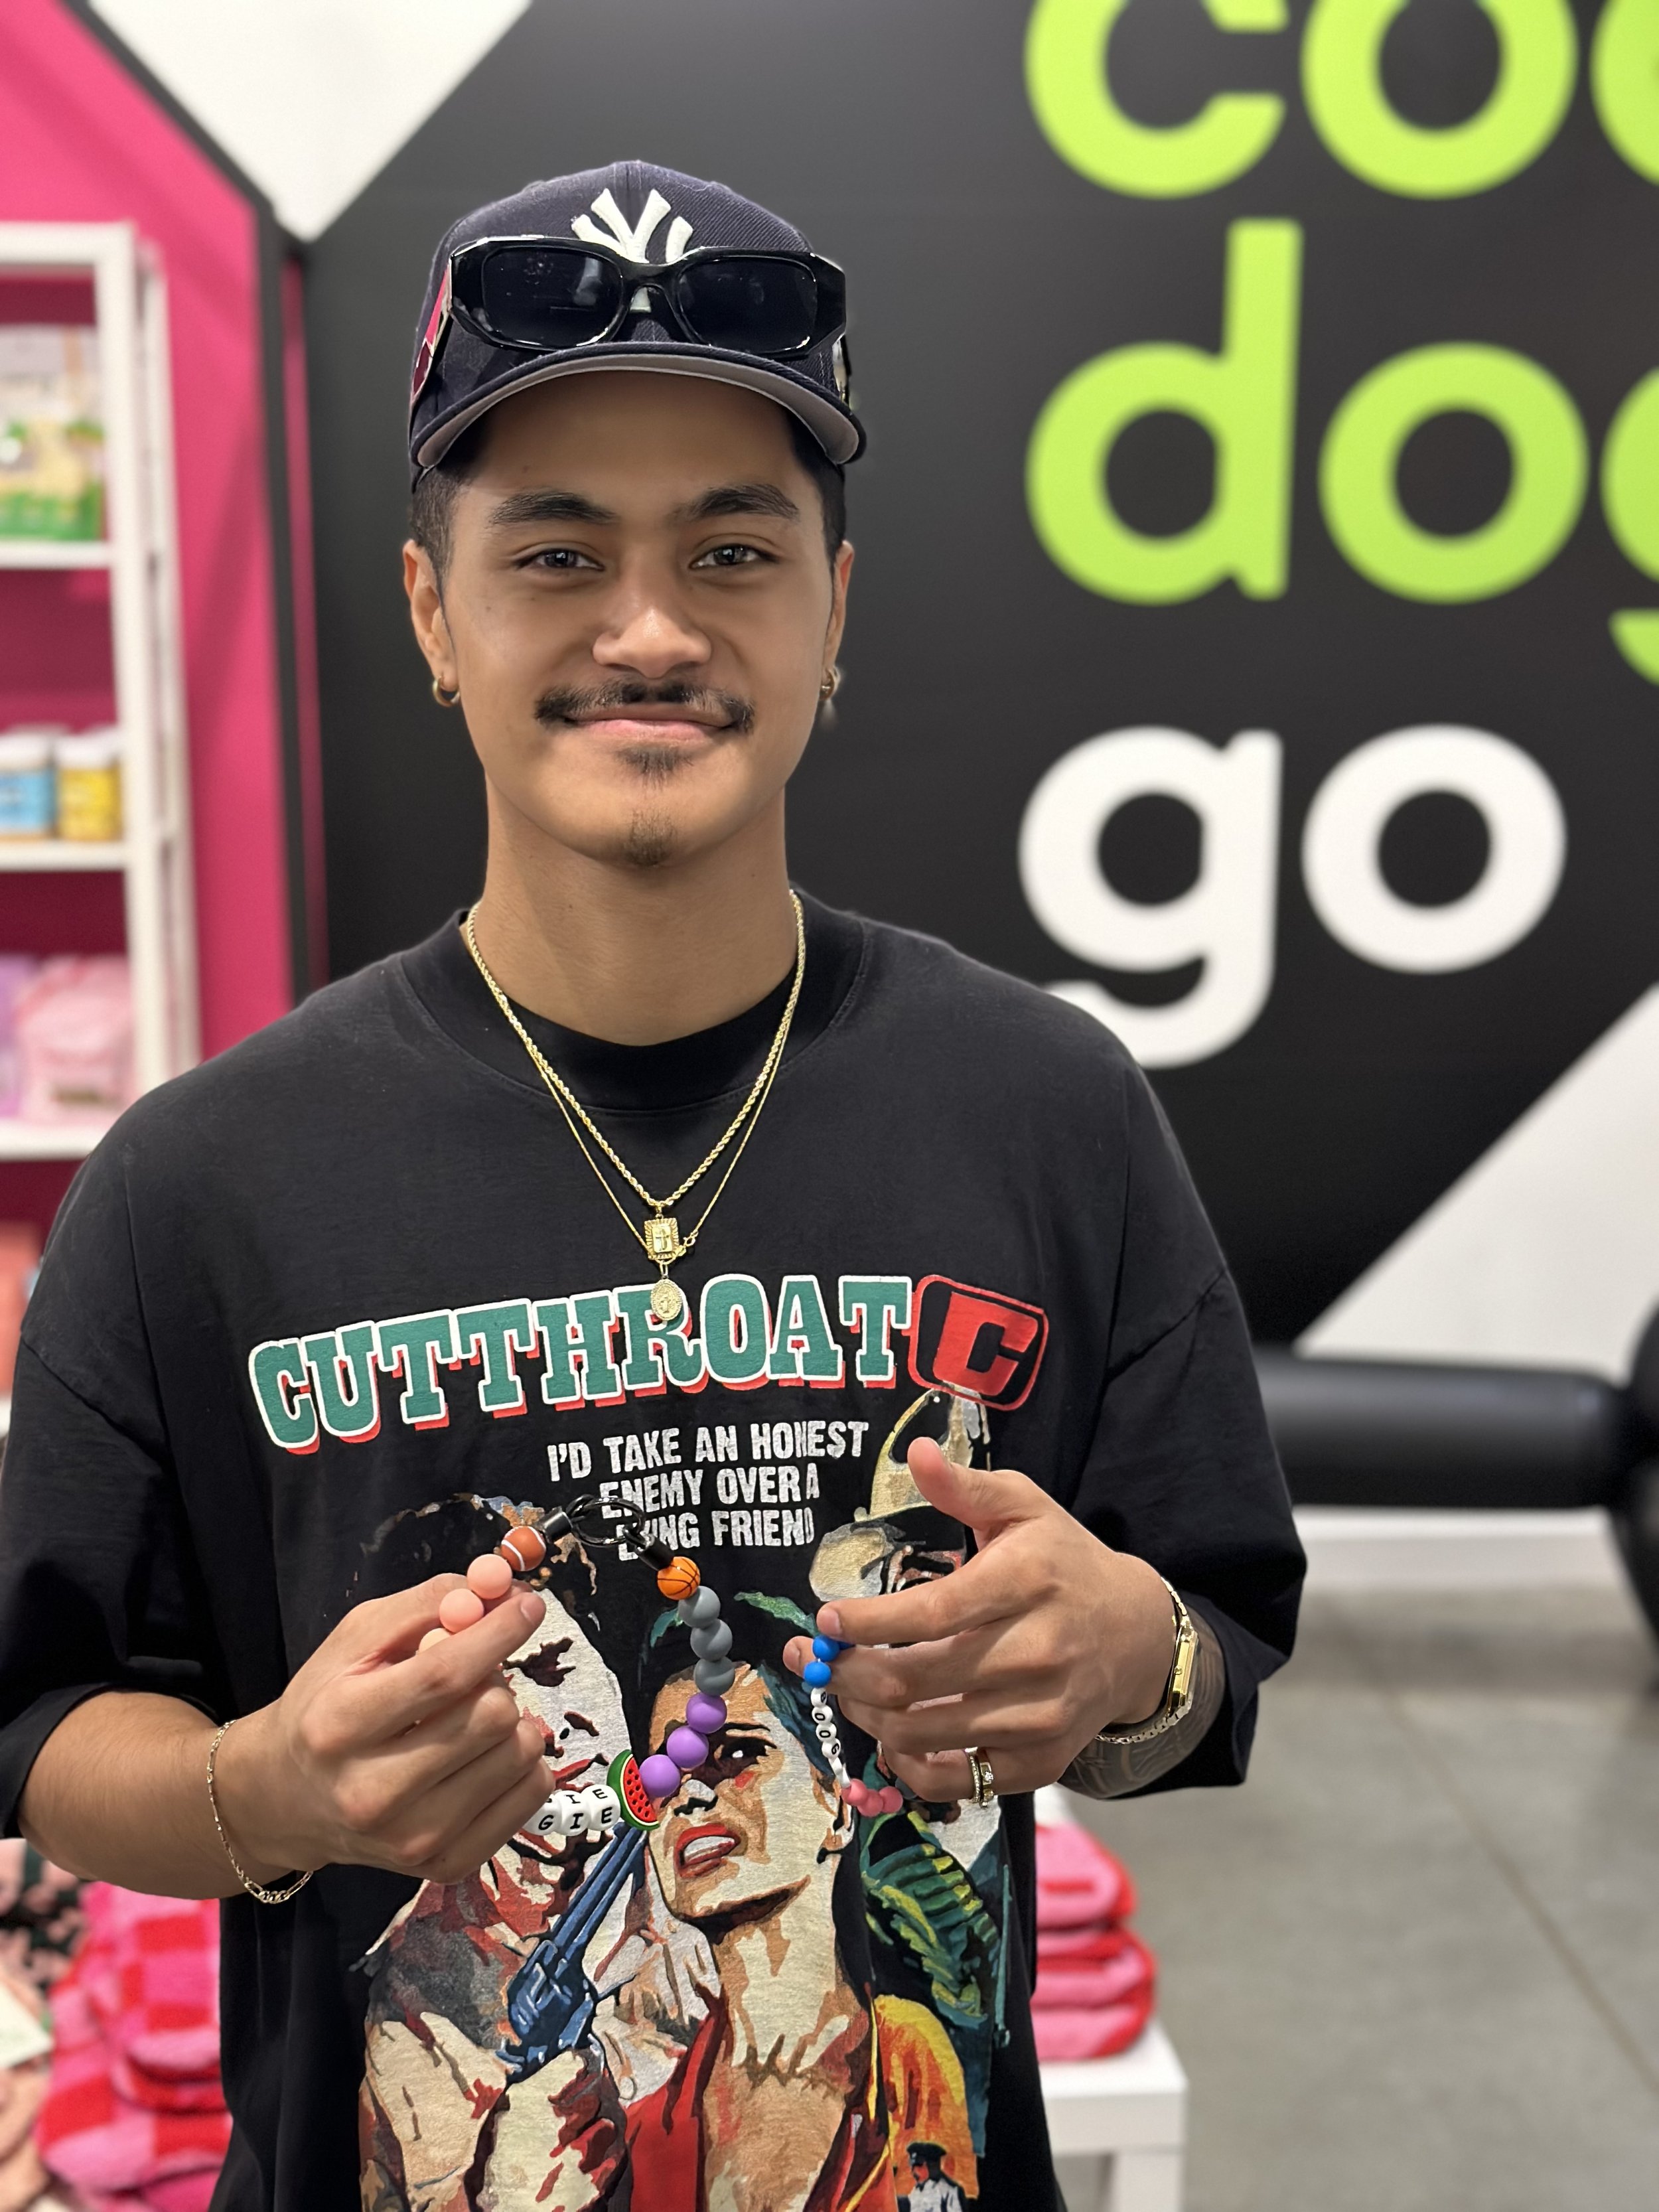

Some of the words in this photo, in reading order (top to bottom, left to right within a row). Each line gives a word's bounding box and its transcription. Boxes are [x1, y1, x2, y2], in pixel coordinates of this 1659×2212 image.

[1025, 0, 1659, 199] co
[1025, 218, 1659, 686] do
[1019, 723, 1567, 1069] go
[248, 1274, 913, 1455] CUTTHROAT
[933, 1291, 1038, 1396] C
[547, 1442, 591, 1481] I'D
[603, 1428, 682, 1474] TAKE
[695, 1426, 738, 1462] AN
[750, 1420, 869, 1459] HONEST
[599, 1469, 703, 1519] ENEMY
[717, 1465, 801, 1505] OVER
[711, 1507, 815, 1546] FRIEND
